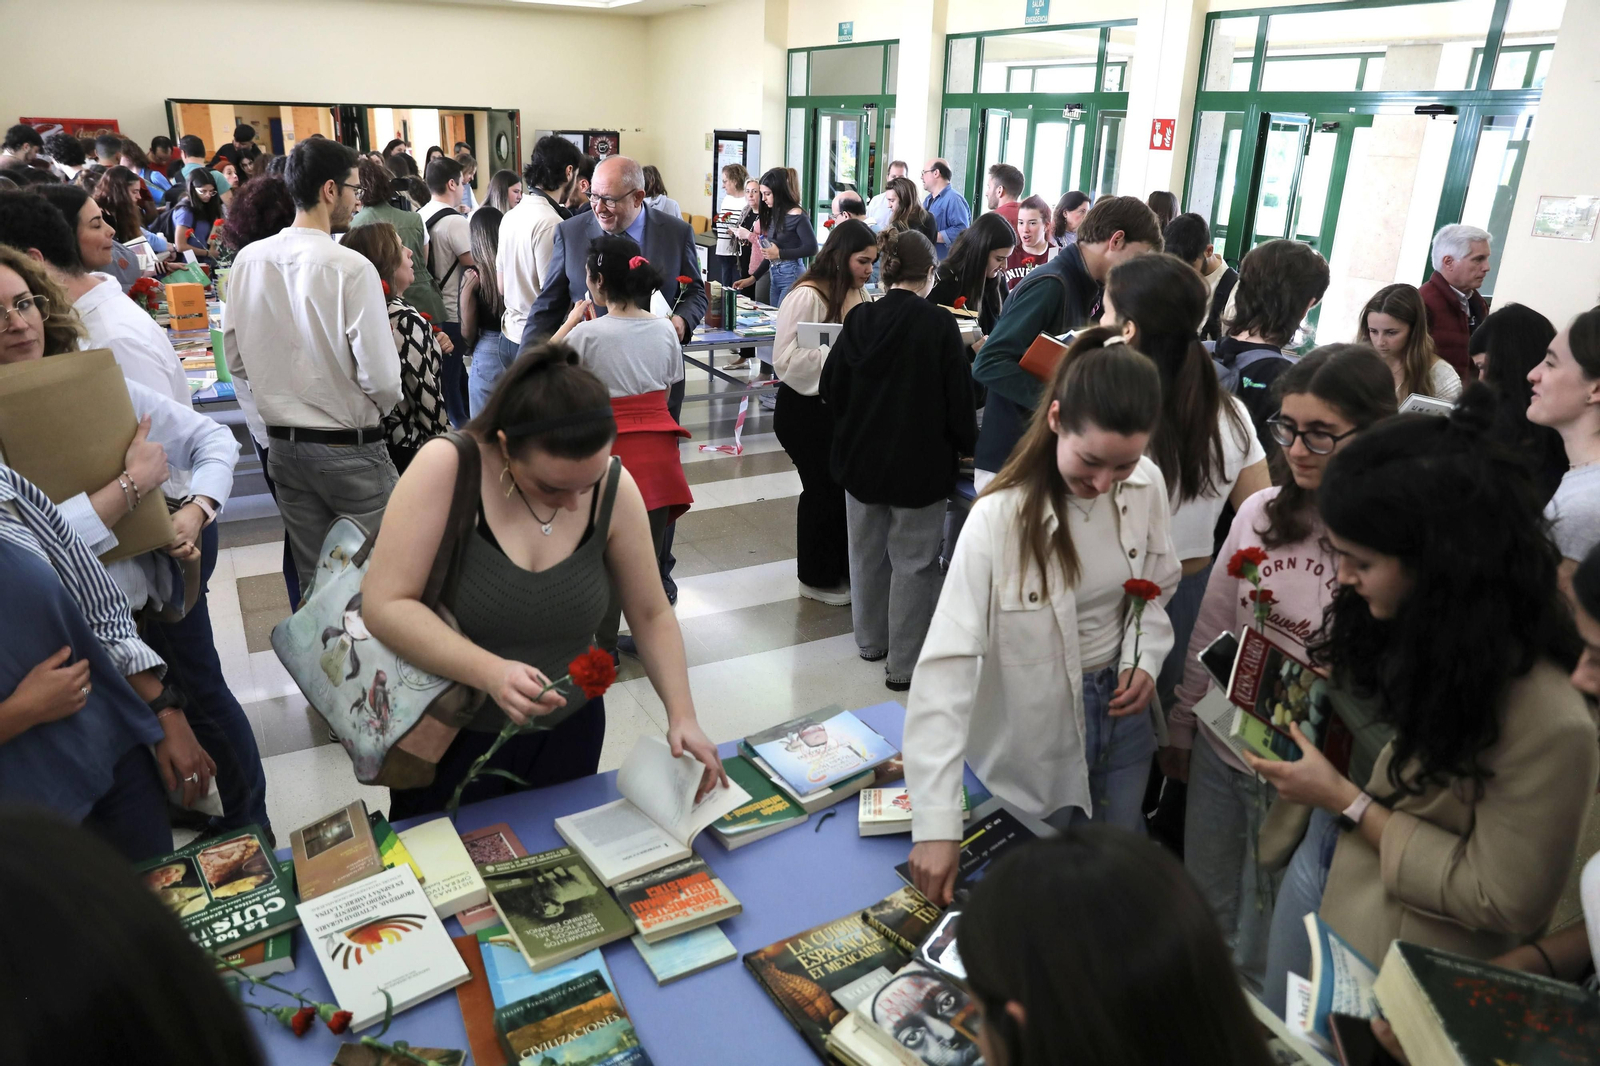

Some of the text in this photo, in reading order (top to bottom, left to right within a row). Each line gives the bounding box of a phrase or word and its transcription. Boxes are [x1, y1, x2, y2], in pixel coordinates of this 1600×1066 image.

[1305, 557, 1325, 577] TO
[371, 883, 396, 896] ESPAÑA
[395, 880, 405, 888] EN
[433, 879, 474, 899] SISTEMAS
[645, 871, 711, 898] DOMESTICI
[364, 895, 387, 908] MEDIO
[629, 890, 682, 913] ANIMALI
[694, 895, 729, 912] Nicola
[314, 905, 341, 919] LATINA
[333, 903, 366, 919] AMBIENTE
[345, 905, 379, 921] ACTIVIDAD
[562, 911, 595, 925] MERINO
[244, 917, 269, 932] La
[535, 930, 550, 939] DEL
[544, 927, 605, 948] FUNDAMENTOS
[785, 938, 813, 957] LA
[796, 928, 886, 970] ESPAGNOLE
[807, 942, 887, 982] ET MEXICAINE
[520, 1012, 621, 1060] CIVILIZACIONES
